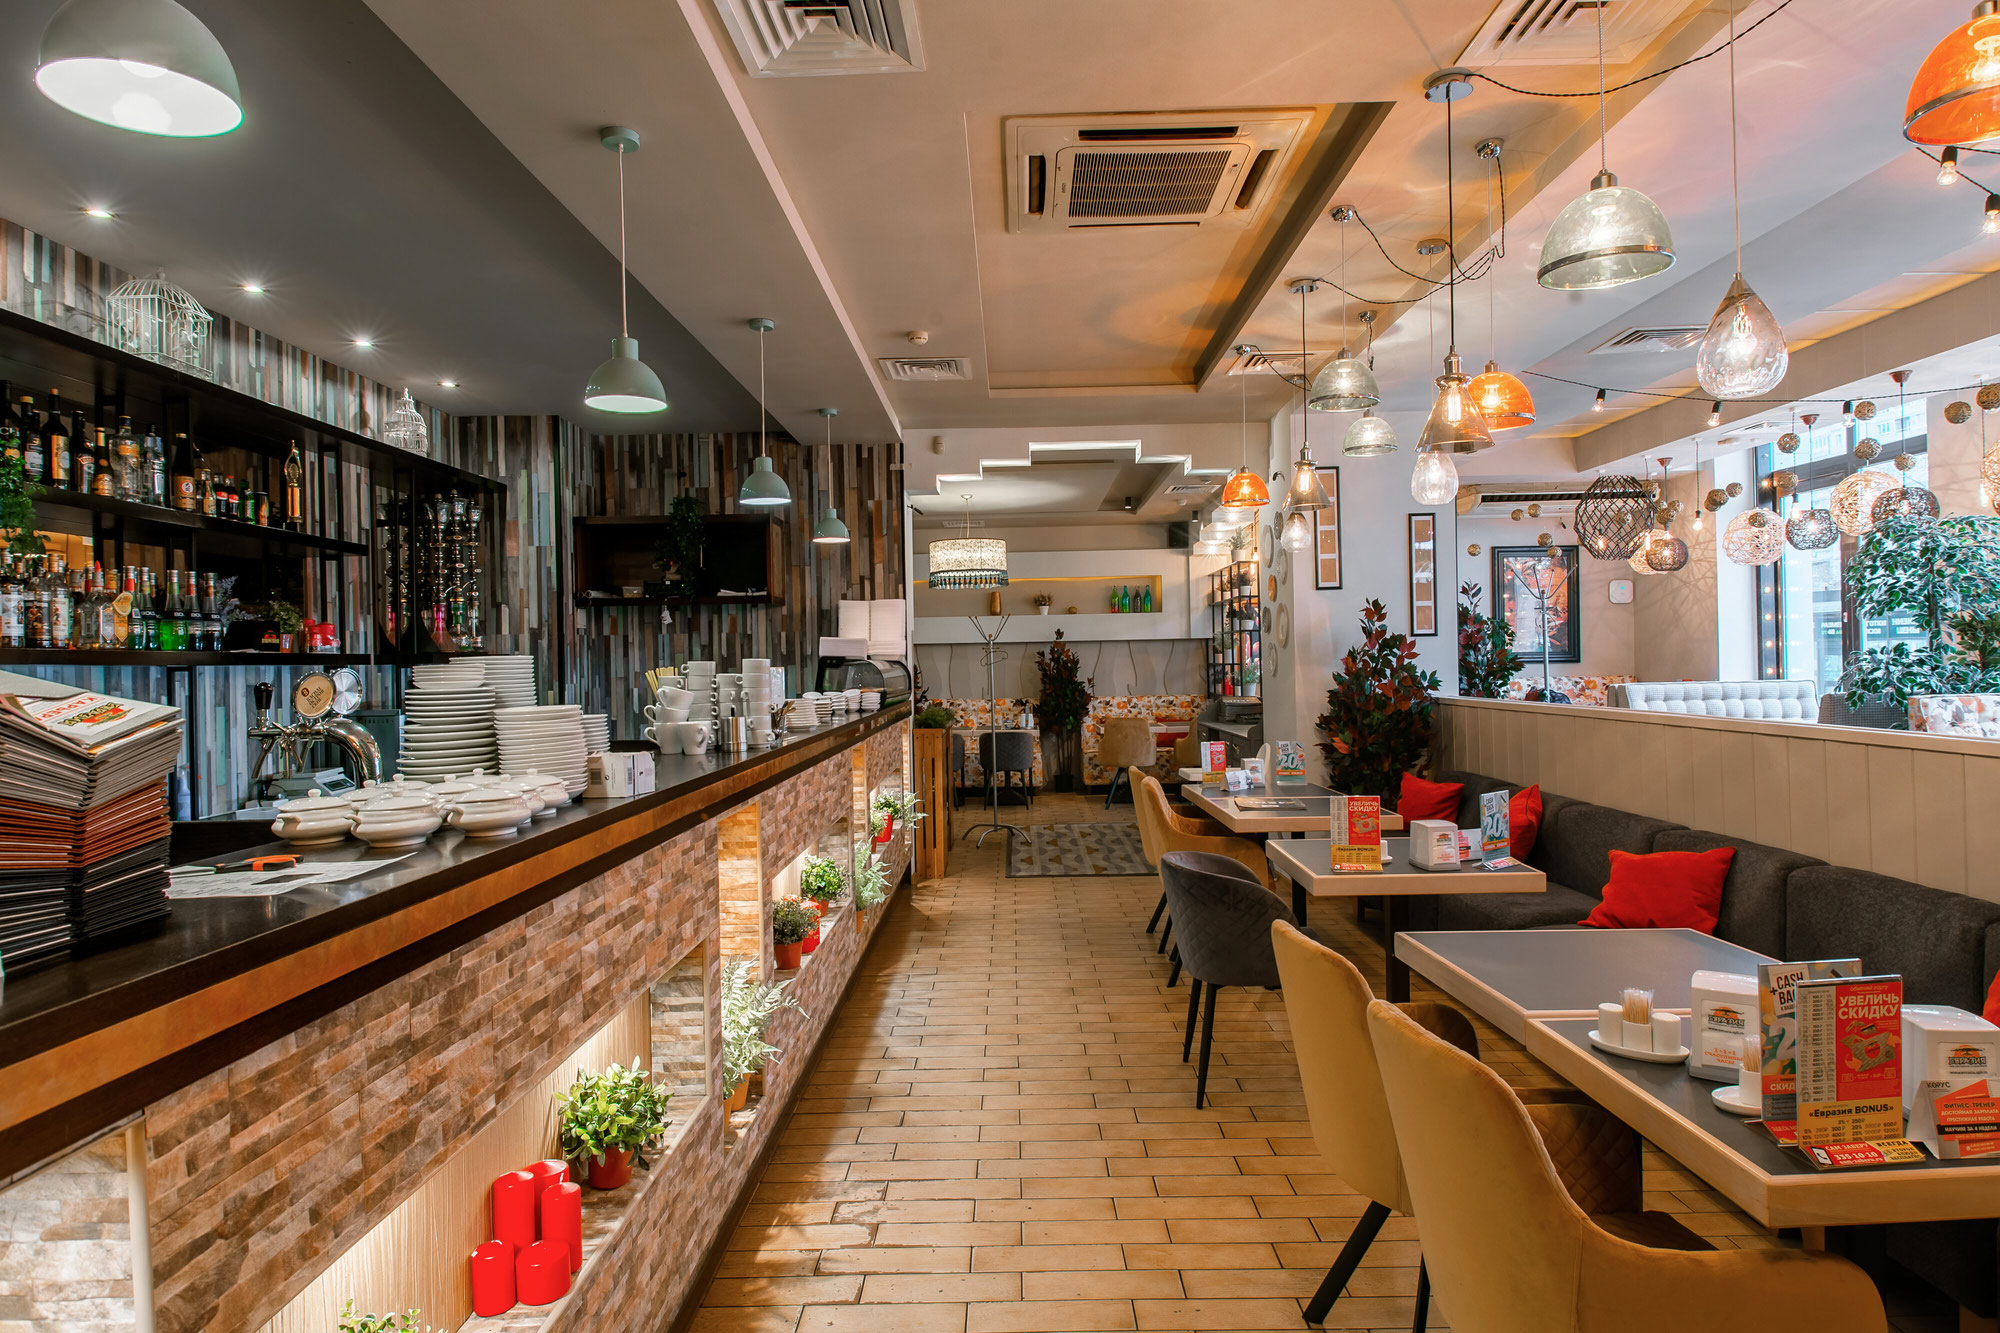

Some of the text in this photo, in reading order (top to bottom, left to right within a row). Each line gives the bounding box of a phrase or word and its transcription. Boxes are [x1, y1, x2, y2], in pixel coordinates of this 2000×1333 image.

[1776, 971, 1804, 990] CASH
[1839, 993, 1900, 1007] УВЕЛИЧЬ
[1838, 1004, 1899, 1020] СКИДКУ
[1769, 1082, 1796, 1091] СКИД
[1855, 1104, 1894, 1114] BONUS»
